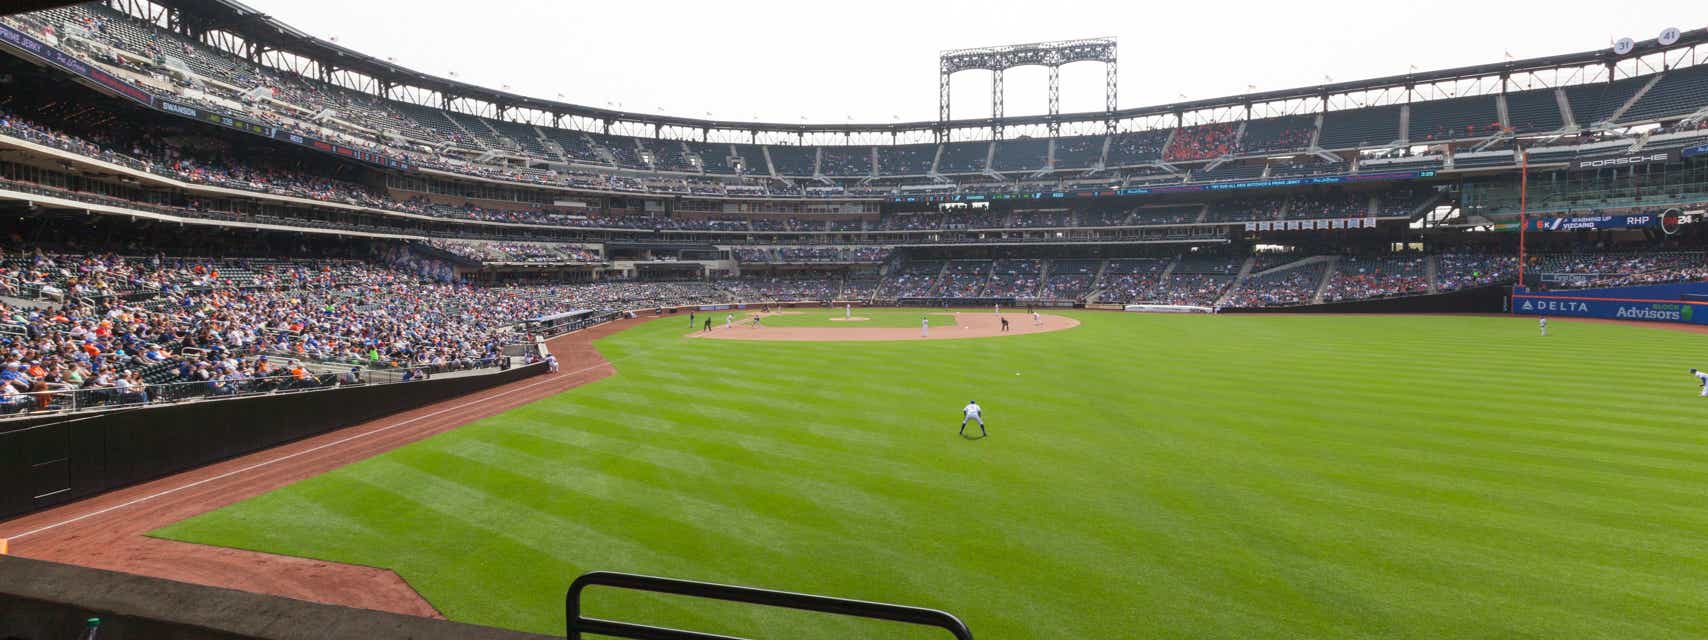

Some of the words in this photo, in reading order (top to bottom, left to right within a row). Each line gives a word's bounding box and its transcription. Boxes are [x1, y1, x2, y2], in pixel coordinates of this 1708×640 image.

[1663, 31, 1675, 40] 41
[1619, 41, 1629, 50] 31
[162, 101, 196, 117] SWANSON
[1579, 153, 1668, 168] PORSCHE
[1626, 216, 1650, 225] RHP
[1537, 301, 1588, 312] DELTA
[1616, 306, 1681, 320] Advisors
